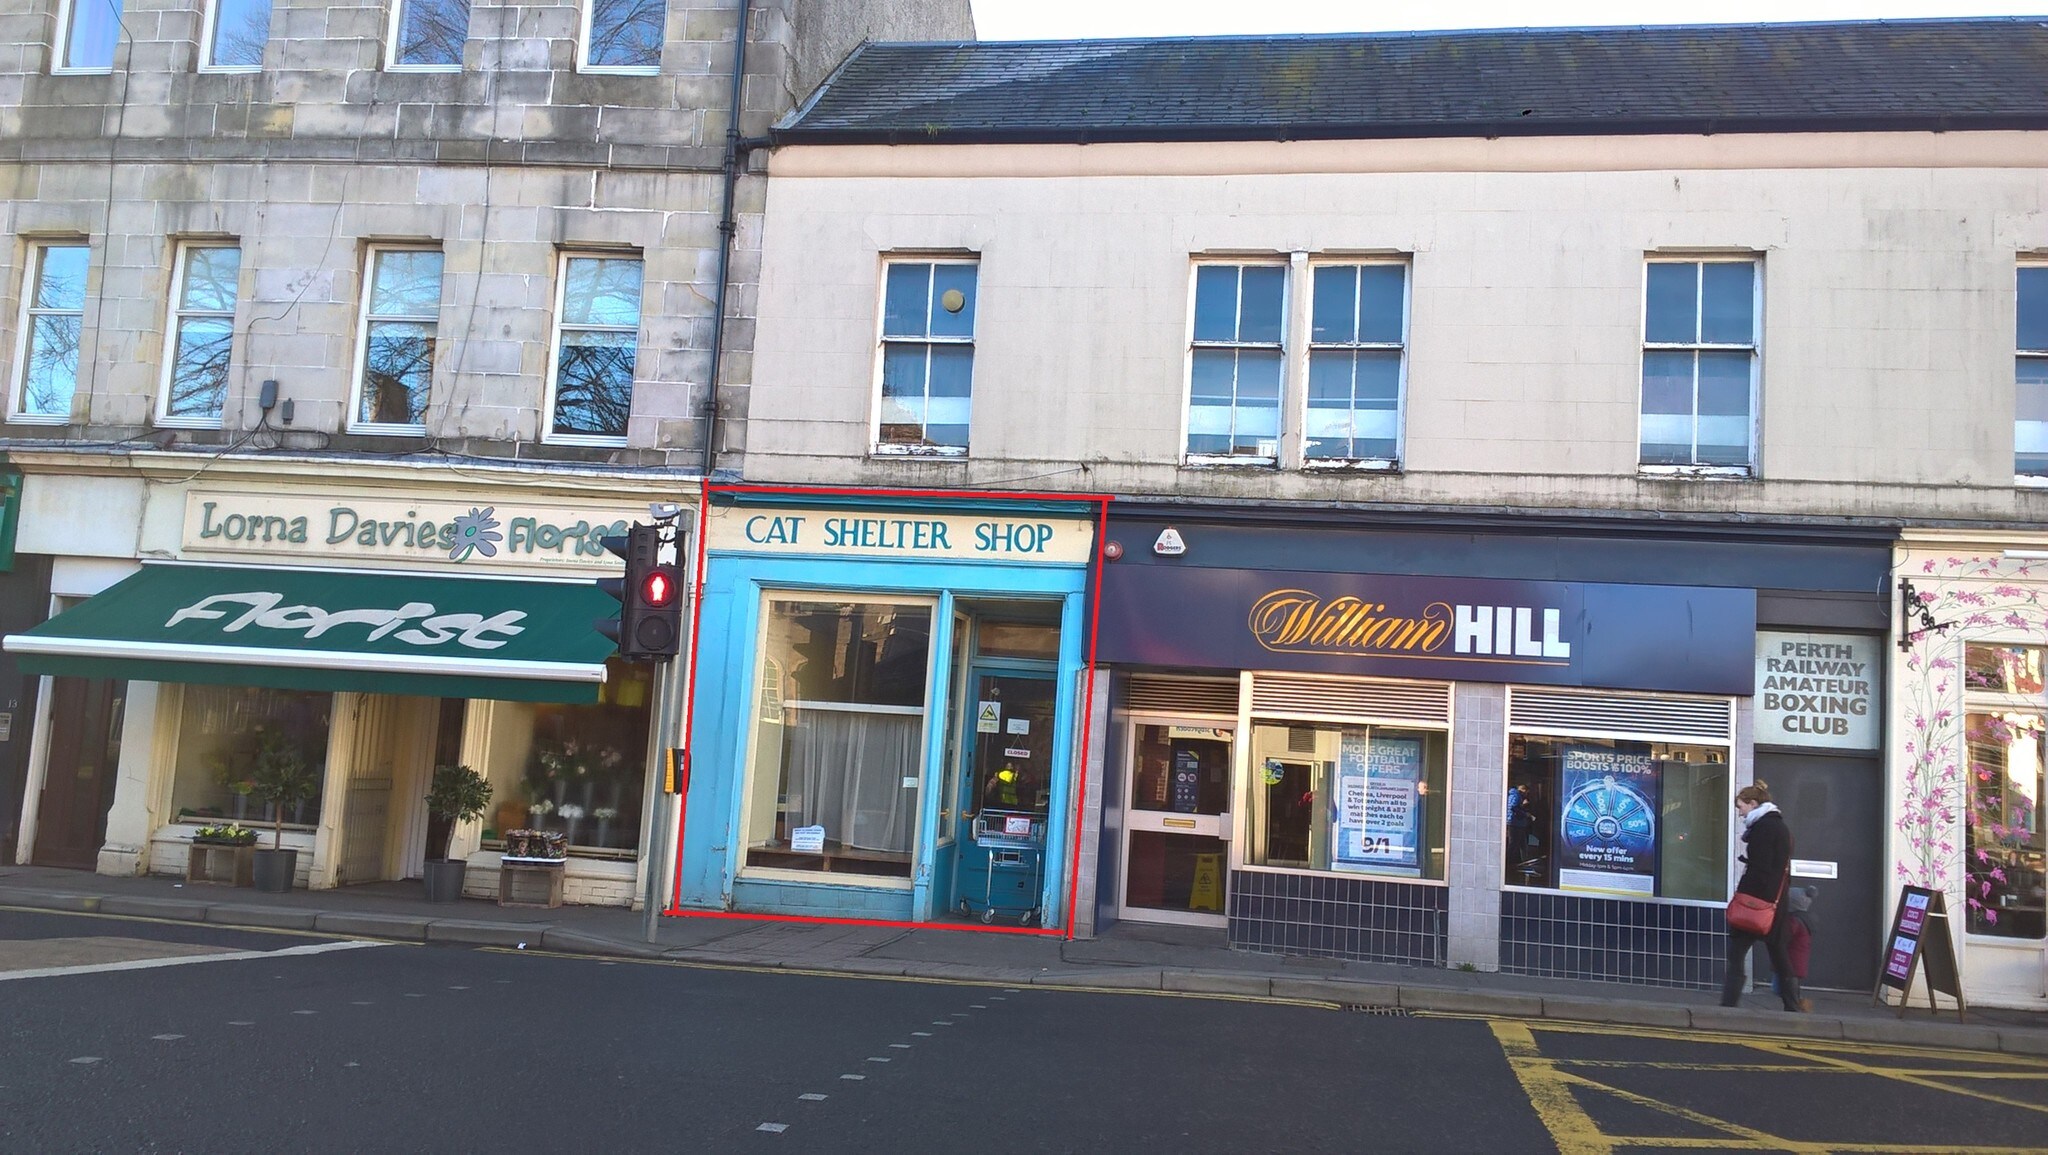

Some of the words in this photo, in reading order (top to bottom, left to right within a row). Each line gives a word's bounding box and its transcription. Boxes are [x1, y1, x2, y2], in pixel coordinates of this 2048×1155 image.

[200, 502, 308, 543] Lorna
[326, 507, 458, 550] Davies
[745, 515, 806, 544] CAT
[823, 518, 952, 550] SHELTER
[974, 522, 1054, 554] SHOP
[164, 591, 528, 650] Florist
[1248, 589, 1455, 653] William
[1455, 604, 1570, 658] HILL
[1781, 641, 1853, 660] PERTH
[1767, 657, 1866, 677] RAILWAY
[1763, 675, 1870, 695] AMATEUR
[8, 699, 18, 708] 13
[1764, 692, 1867, 716] BOXING
[1782, 714, 1849, 736] CLUB
[1378, 745, 1416, 757] GREAT
[1566, 751, 1615, 763] SPORTS
[1616, 754, 1652, 765] PRICE
[1349, 753, 1408, 766] FOOTBALL
[1566, 760, 1610, 771] BOOSTS
[1620, 763, 1652, 774] 100%
[1347, 790, 1375, 798] Chelea,
[1376, 792, 1407, 800] Liverpool
[1353, 797, 1389, 805] Totenham
[1627, 819, 1646, 828] 50%
[1362, 836, 1390, 853] 9/1
[1586, 844, 1605, 853] New
[1606, 846, 1628, 855] offer
[1579, 852, 1602, 861] every
[1603, 853, 1612, 861] 15
[1613, 854, 1634, 863] mins
